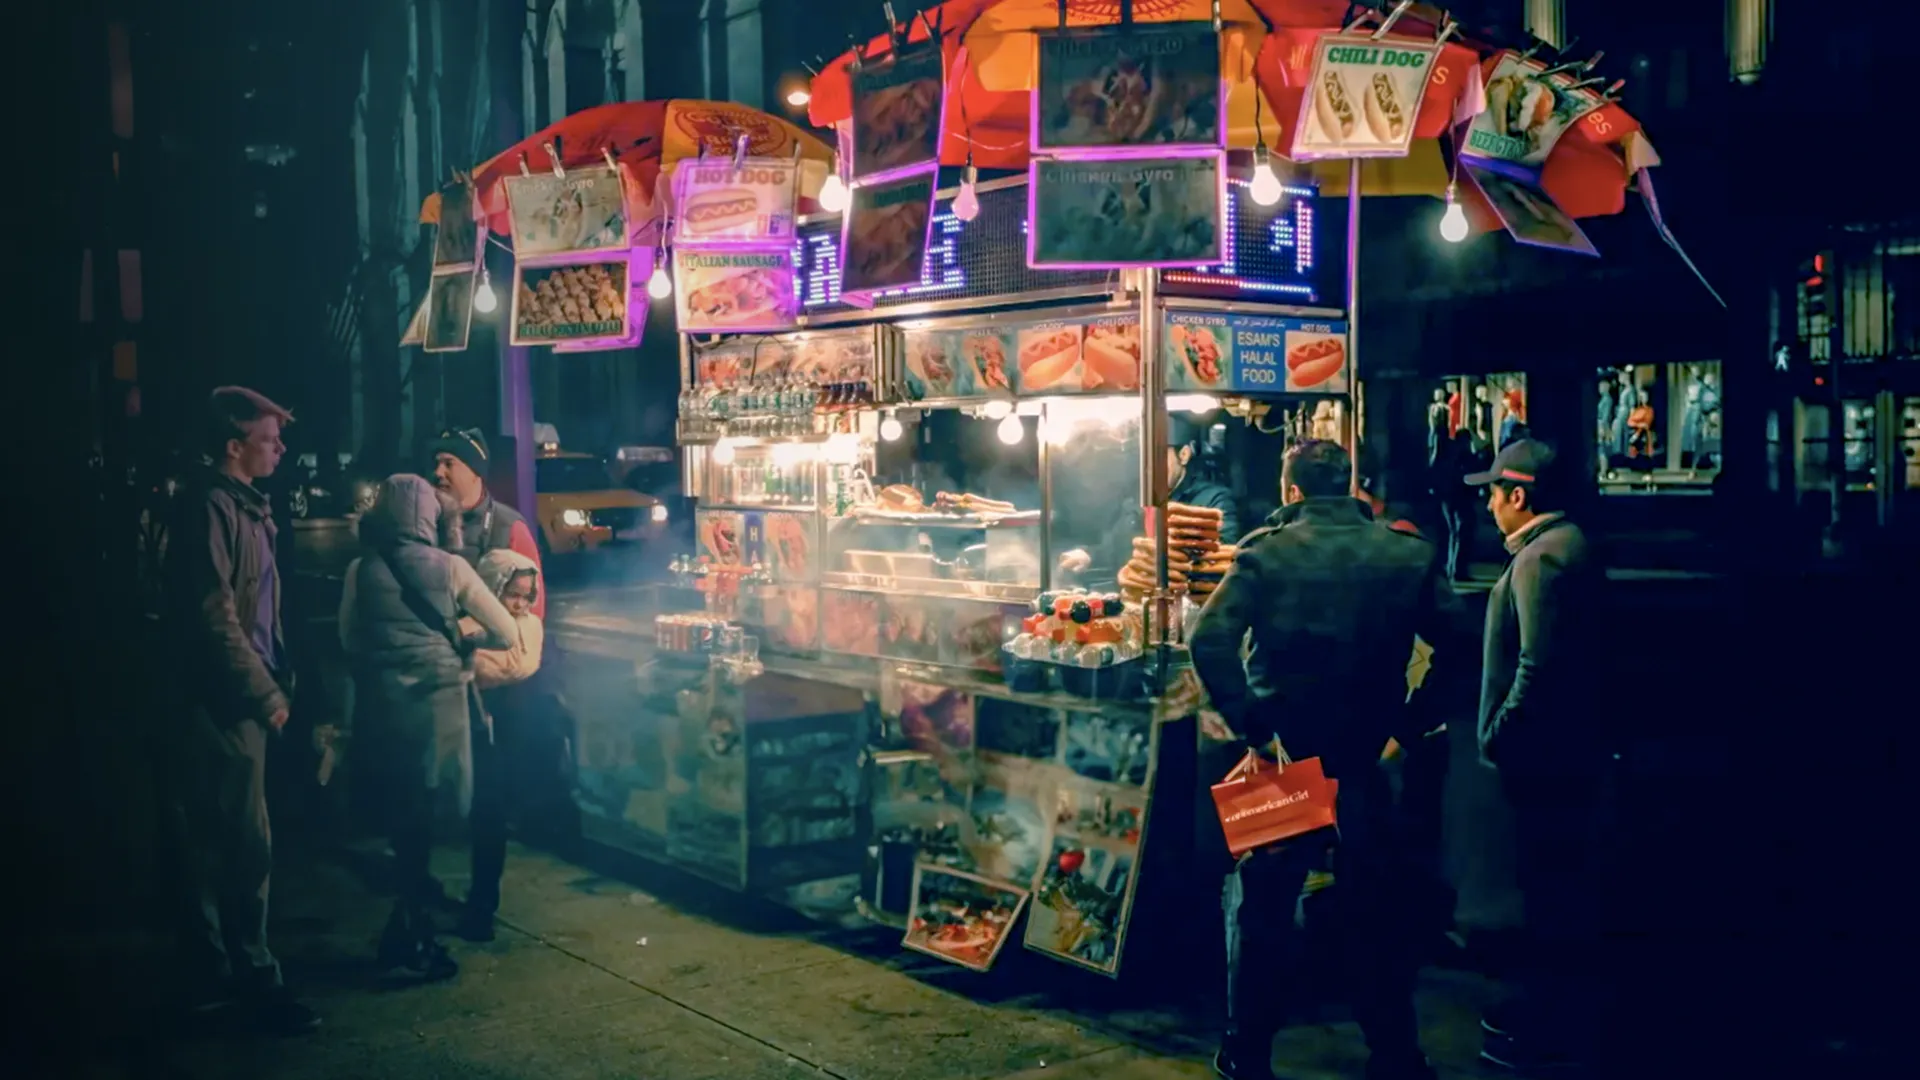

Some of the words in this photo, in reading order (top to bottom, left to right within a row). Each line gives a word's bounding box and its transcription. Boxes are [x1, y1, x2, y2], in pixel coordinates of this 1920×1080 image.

[1328, 47, 1379, 65] CHILI
[1381, 50, 1426, 68] DOG
[694, 169, 734, 185] HOT
[741, 169, 786, 186] DOG
[1131, 168, 1175, 185] Gyro
[566, 179, 595, 194] Gyro
[680, 254, 730, 268] ITALIAN
[732, 254, 783, 268] SAUSAGE
[1171, 314, 1204, 326] CHICKEN
[1205, 316, 1226, 327] GYRO
[1300, 323, 1315, 333] HOT
[1315, 324, 1331, 334] DOG
[1237, 331, 1280, 347] ESAM'S
[1240, 350, 1278, 365] HALAL
[1242, 368, 1276, 384] FOOD
